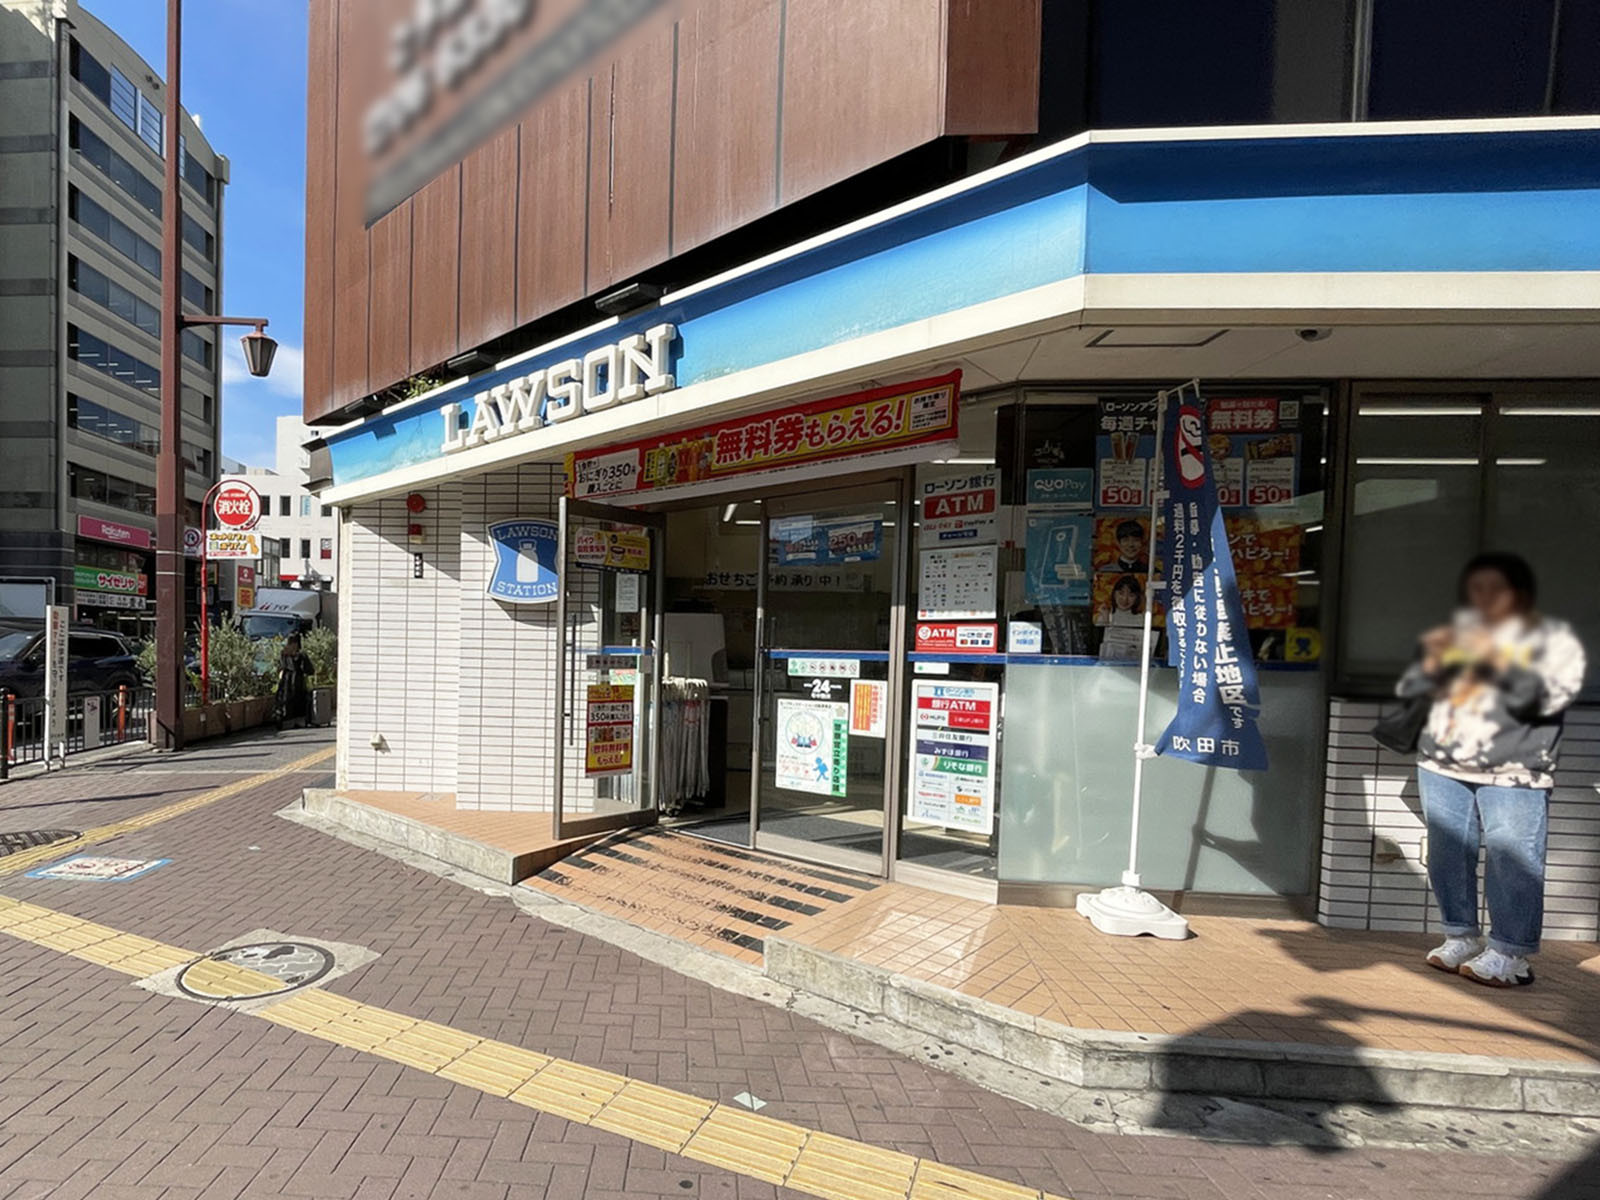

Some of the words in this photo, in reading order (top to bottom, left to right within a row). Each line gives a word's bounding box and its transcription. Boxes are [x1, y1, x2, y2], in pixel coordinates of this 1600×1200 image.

[441, 323, 677, 453] LAWSON
[1211, 408, 1275, 430] 無料券
[715, 400, 906, 464] 無料券もらえる!
[924, 473, 996, 495] ローソン銀行
[218, 498, 252, 515] 消火栓
[935, 493, 984, 516] ATM
[101, 524, 131, 539] Rakuten
[496, 524, 558, 541] LAWSON
[97, 572, 137, 592] サイゼリヤ
[705, 571, 841, 587] おせちご約承り中!
[496, 582, 559, 597] STATION
[930, 628, 955, 638] ATM
[812, 679, 831, 694] 24
[931, 699, 977, 712] 銀行ATM
[932, 733, 973, 743] 三井住友銀行
[1172, 735, 1240, 756] 吹田市
[934, 747, 969, 758] みずほ銀行
[943, 760, 983, 774] りそな銀行
